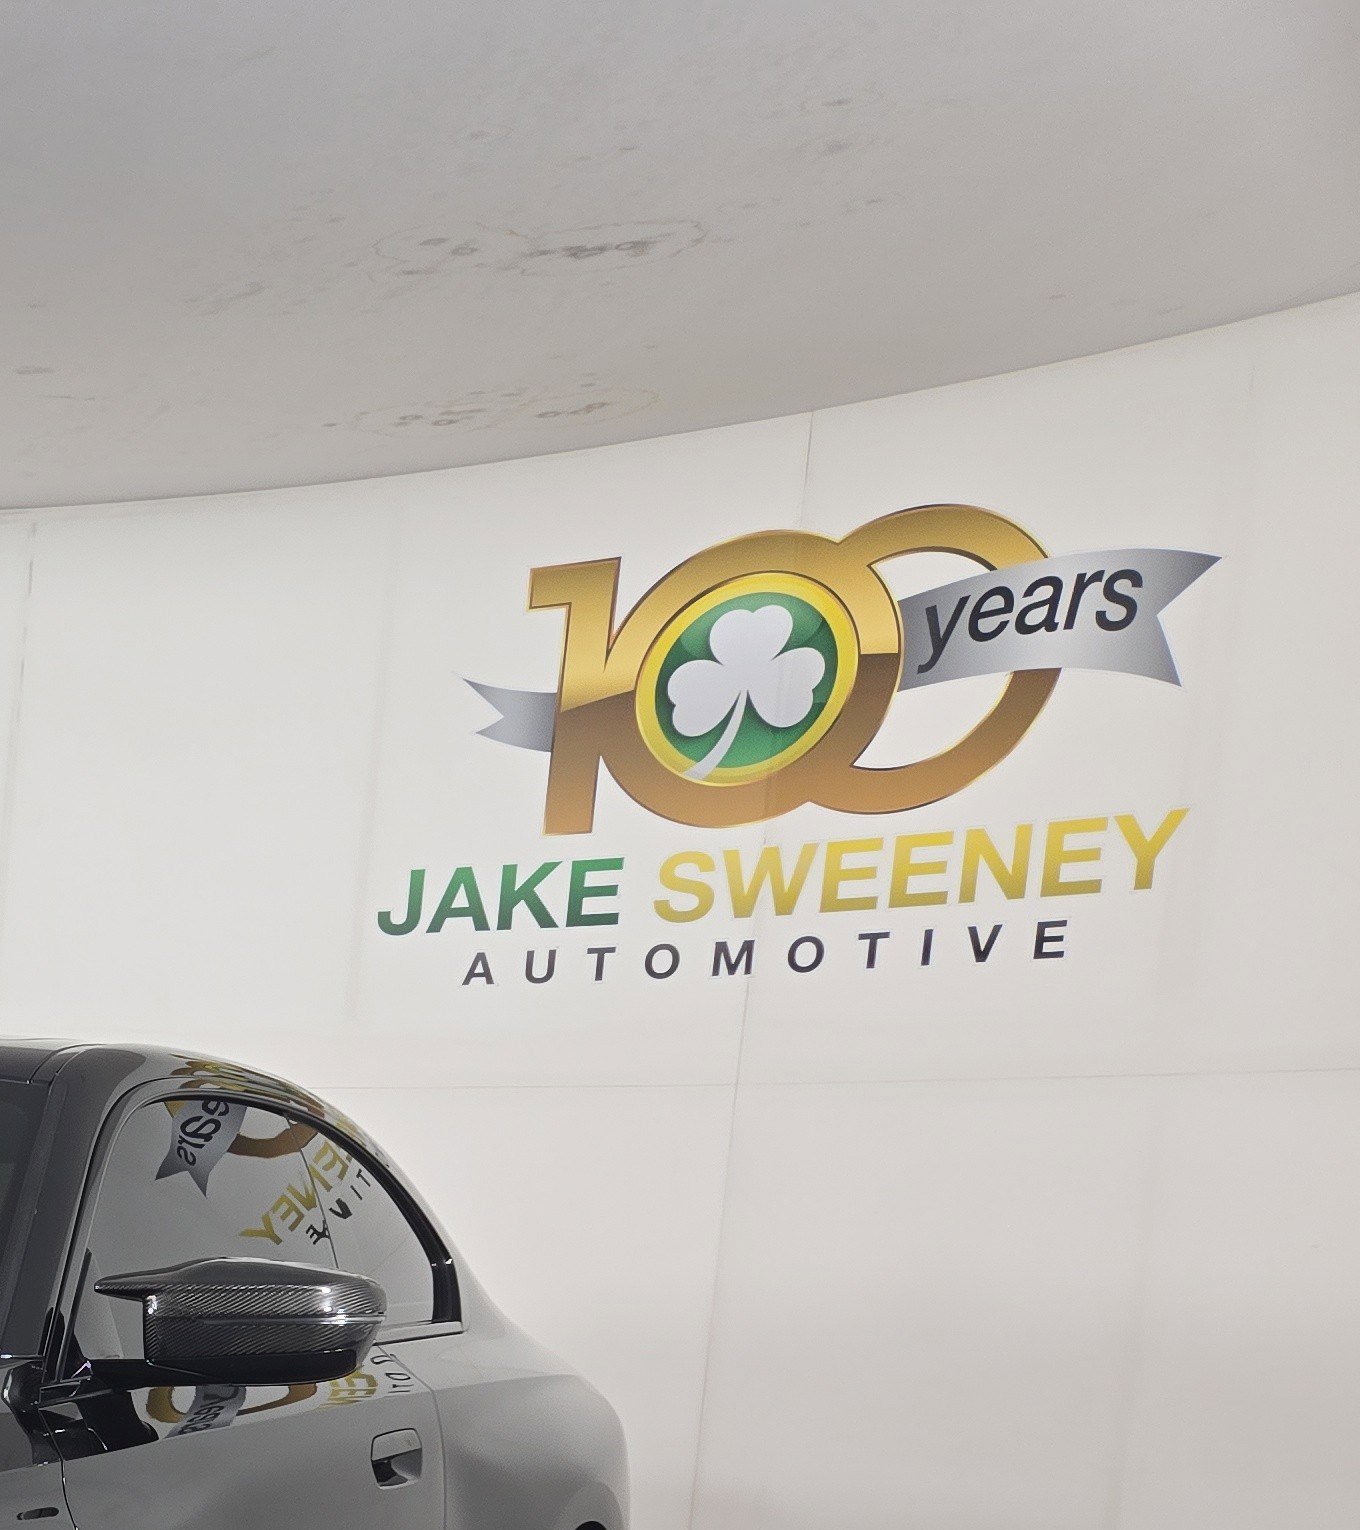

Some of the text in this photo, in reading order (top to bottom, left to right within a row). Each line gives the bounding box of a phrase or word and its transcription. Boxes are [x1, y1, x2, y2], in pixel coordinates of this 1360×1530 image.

[529, 504, 1144, 836] 100 years
[377, 808, 1191, 936] JAKE SWEENEY
[462, 919, 1070, 987] AUTOMOTIVE
